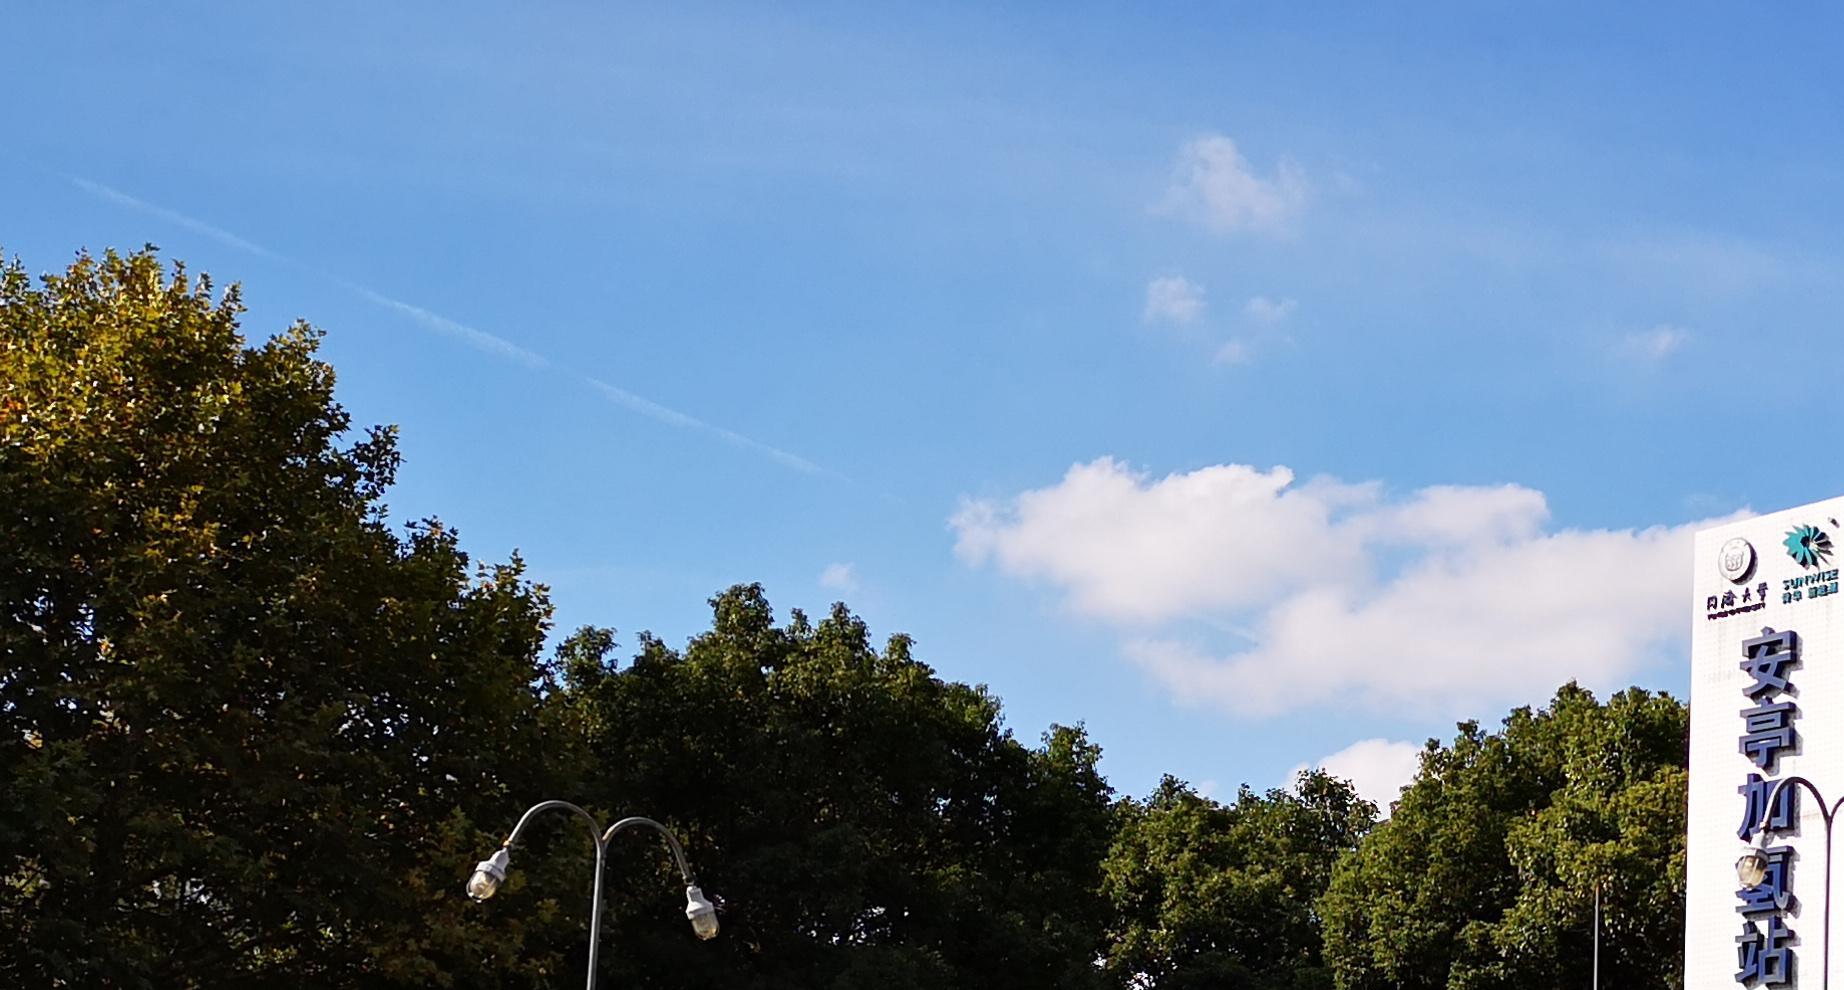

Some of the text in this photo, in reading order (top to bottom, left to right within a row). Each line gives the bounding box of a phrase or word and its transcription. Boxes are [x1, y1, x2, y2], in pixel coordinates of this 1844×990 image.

[1735, 626, 1801, 990] 安亭加氢站
